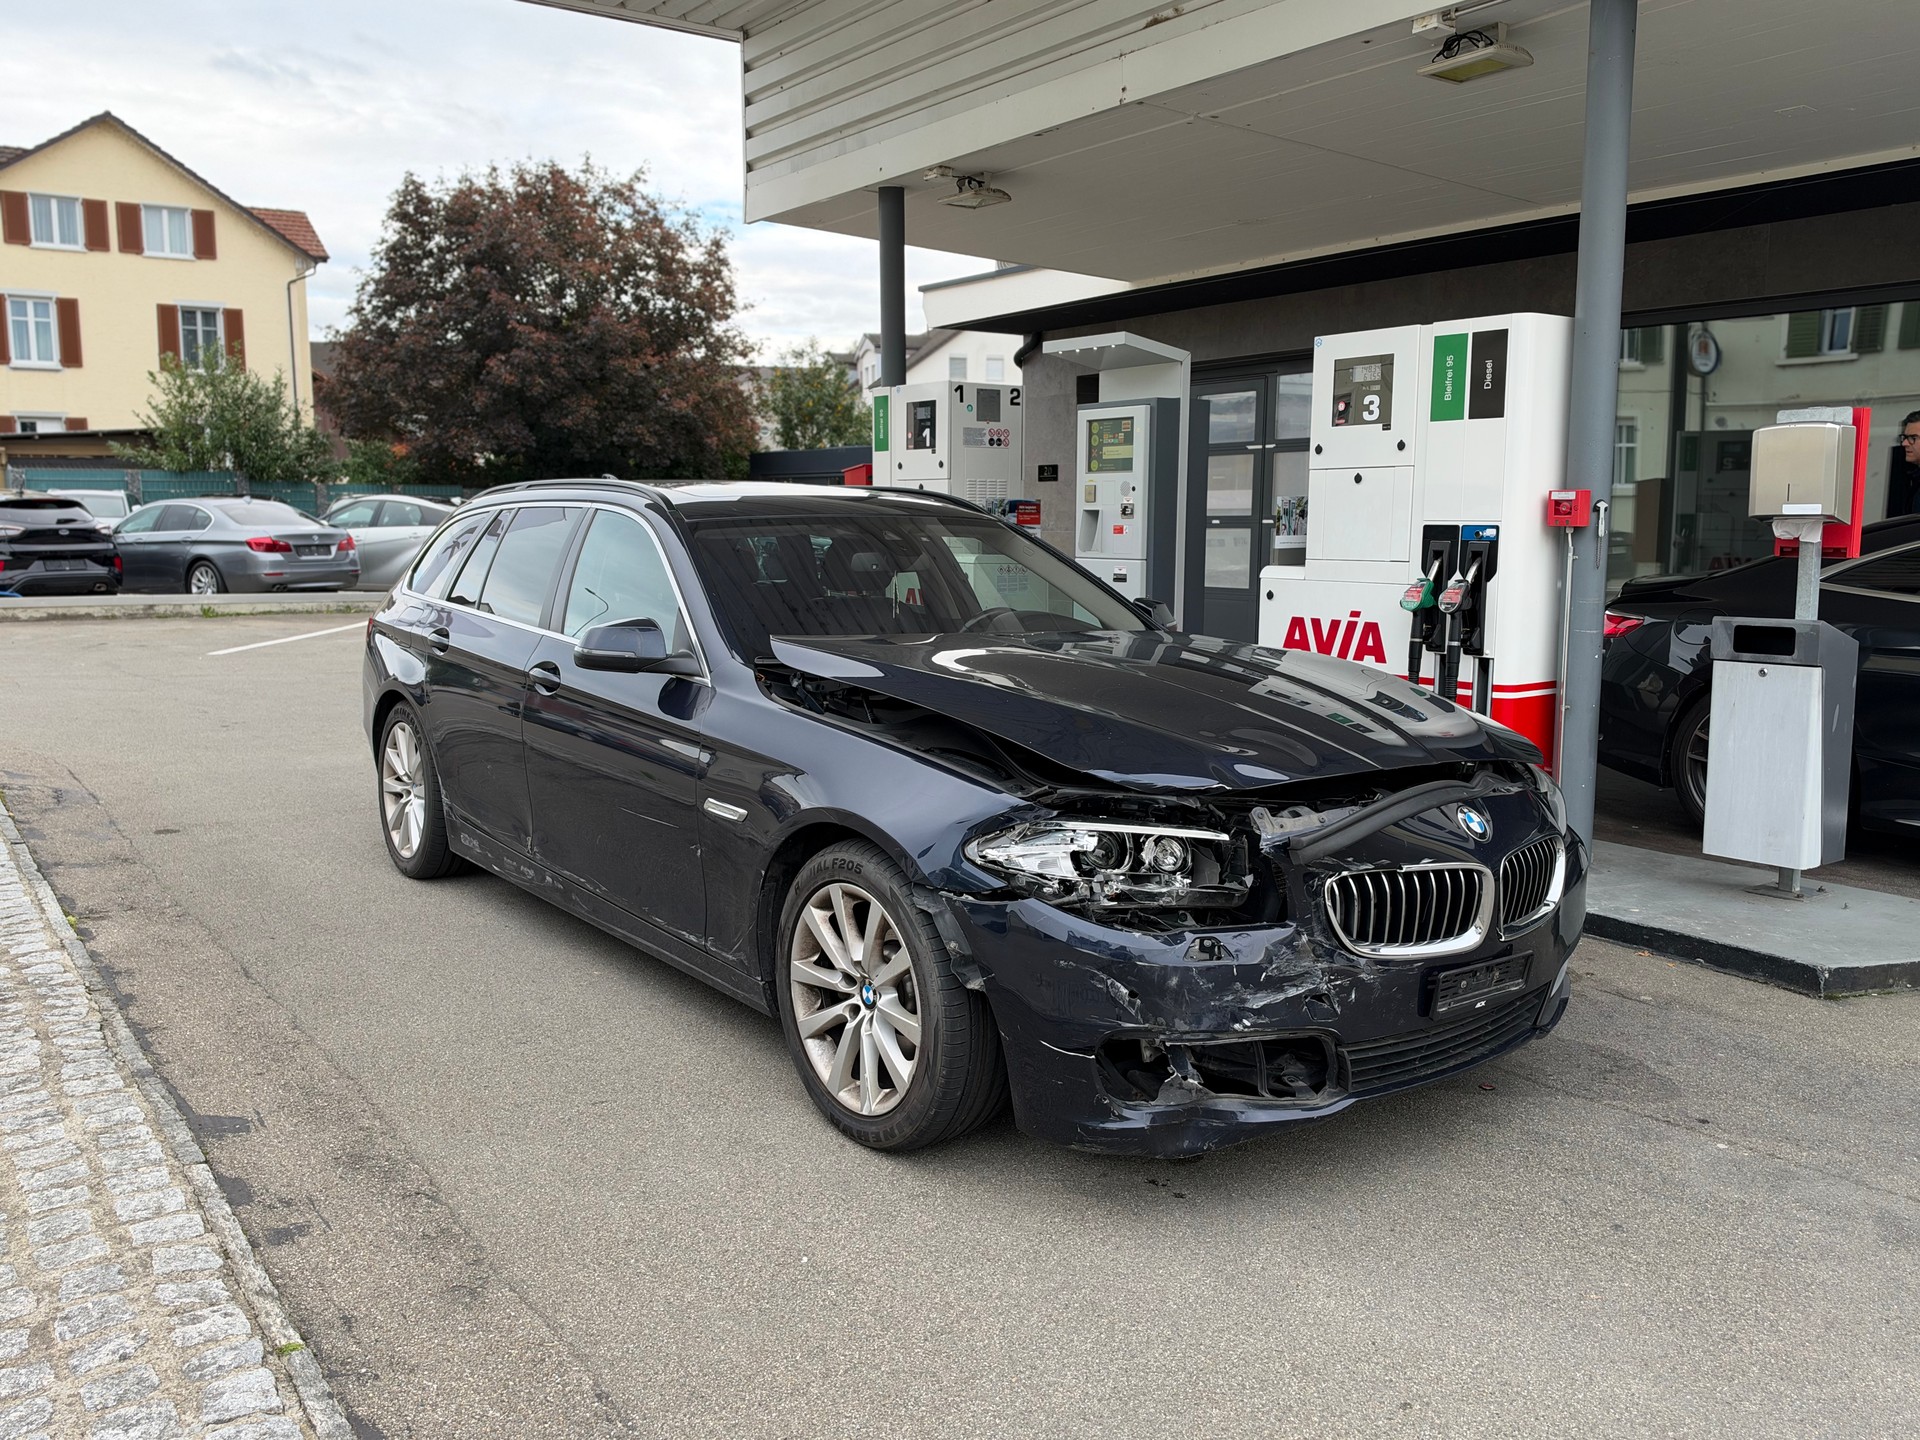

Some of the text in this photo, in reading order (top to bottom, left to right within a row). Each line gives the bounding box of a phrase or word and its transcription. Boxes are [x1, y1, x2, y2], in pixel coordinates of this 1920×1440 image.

[1444, 354, 1454, 401] Bleifrei 95
[1483, 359, 1493, 390] Diesel
[953, 384, 964, 403] 1
[1009, 387, 1021, 406] 2
[1362, 394, 1381, 421] 3
[922, 427, 931, 447] 1
[832, 857, 864, 875] F205
